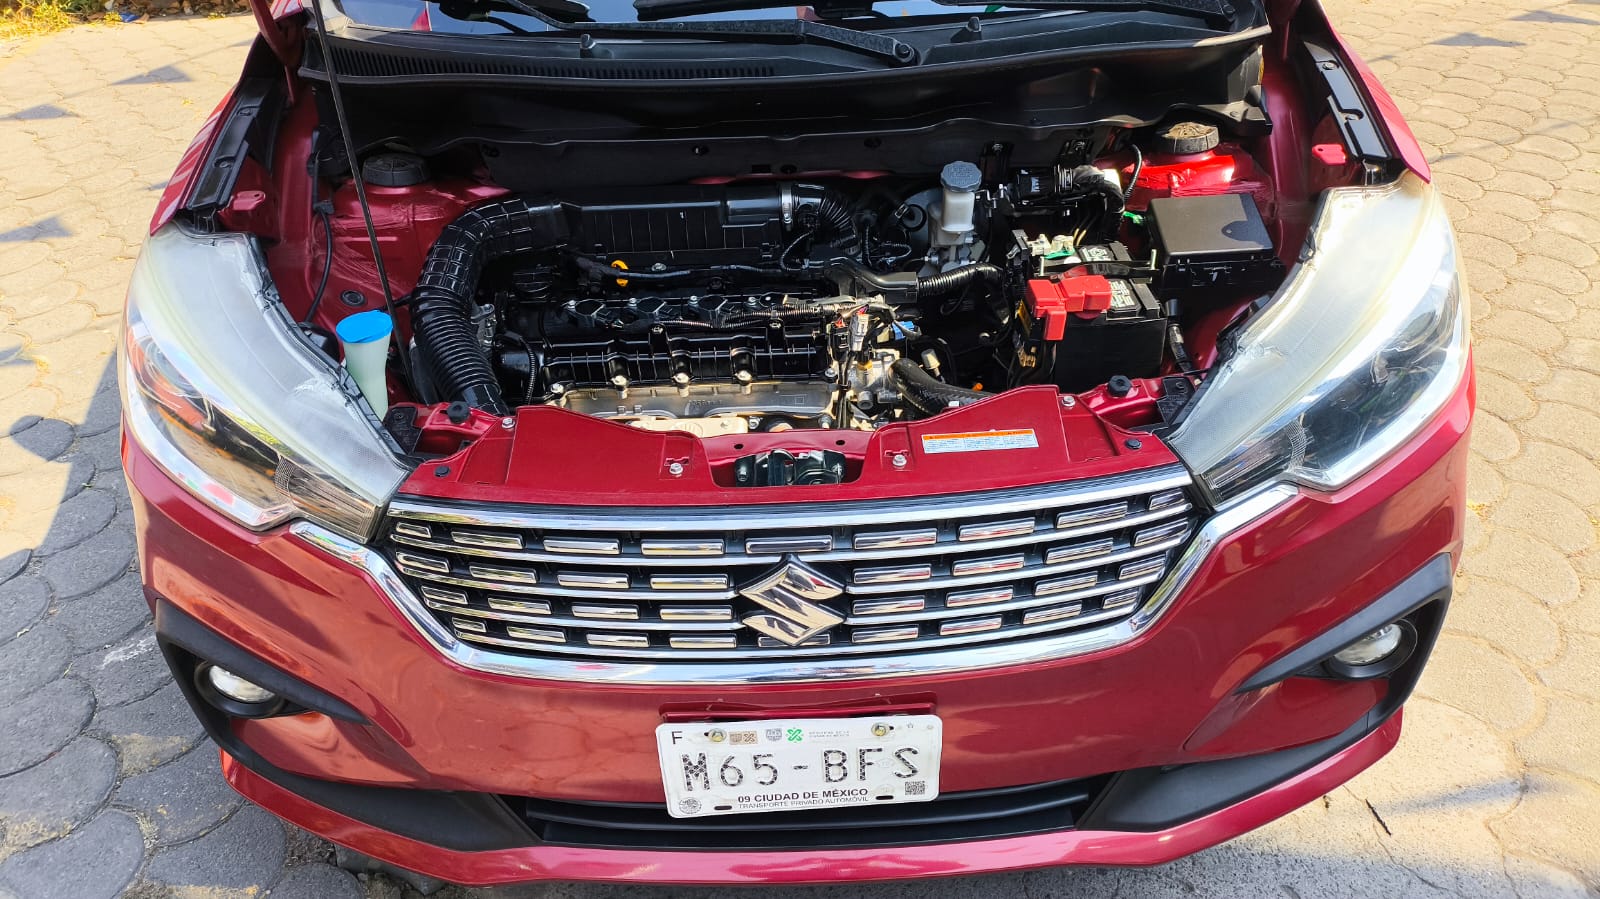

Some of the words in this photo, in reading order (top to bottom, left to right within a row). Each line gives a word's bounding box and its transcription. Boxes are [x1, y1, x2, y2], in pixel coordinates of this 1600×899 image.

[671, 731, 683, 745] F
[738, 795, 750, 804] 09
[754, 792, 800, 803] CIUDAD
[803, 791, 818, 800] DE
[822, 788, 868, 798] MÉXICO
[738, 801, 788, 809] TRANSPORTE
[825, 796, 869, 804] AUTOMÓVIL
